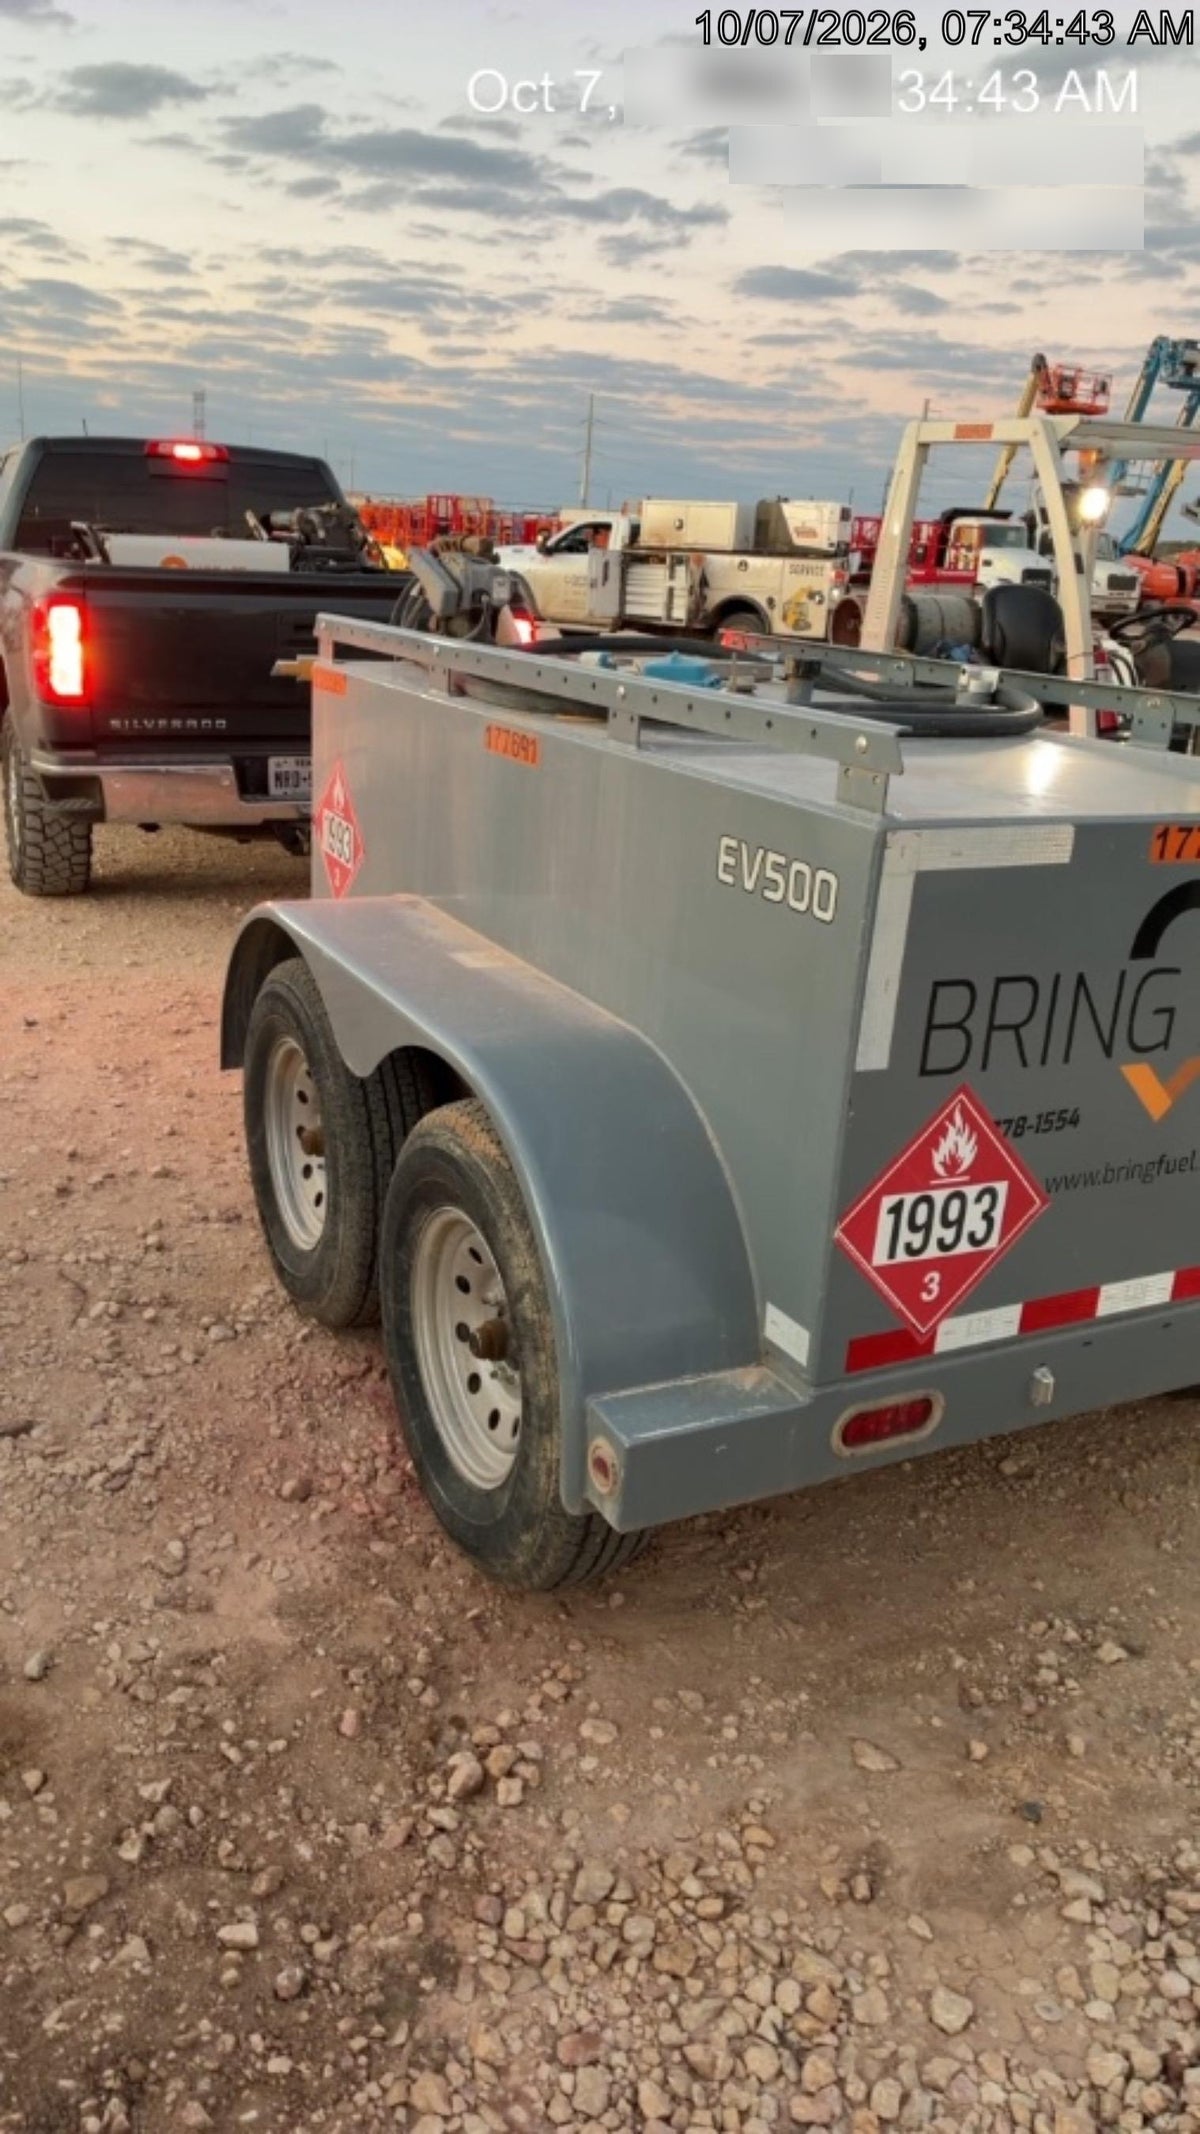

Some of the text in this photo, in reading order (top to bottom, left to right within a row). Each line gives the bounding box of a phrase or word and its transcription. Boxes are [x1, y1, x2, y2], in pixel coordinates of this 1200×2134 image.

[108, 717, 227, 731] SILVERADO
[717, 834, 839, 925] EV500
[918, 966, 1182, 1077] BRING
[886, 1185, 999, 1260] 1993
[919, 1270, 941, 1303] 3
